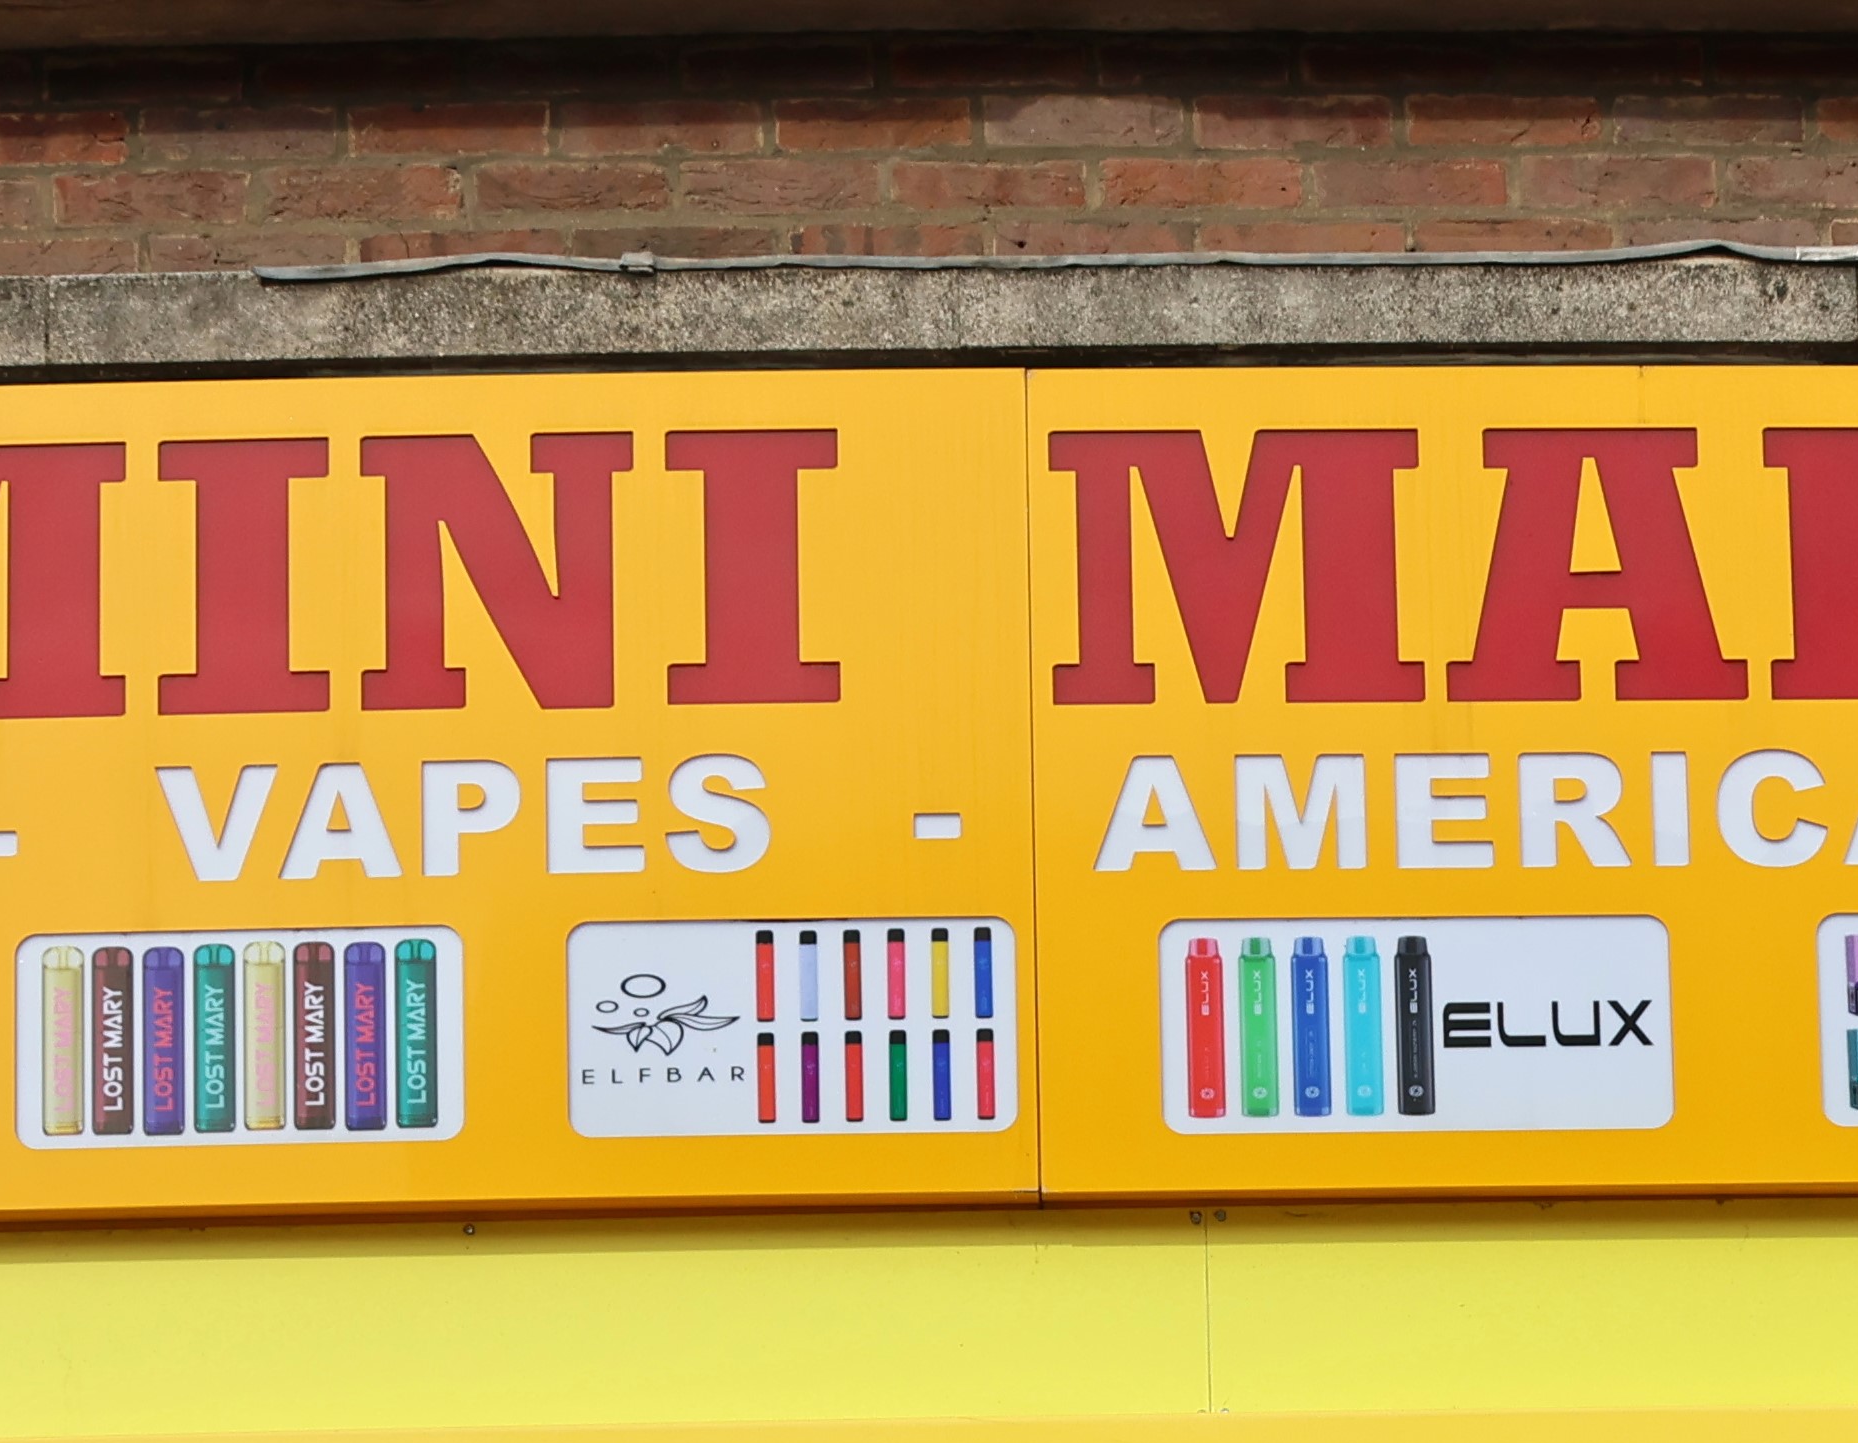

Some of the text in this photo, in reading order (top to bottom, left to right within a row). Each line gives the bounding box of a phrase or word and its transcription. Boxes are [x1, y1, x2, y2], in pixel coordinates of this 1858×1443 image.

[155, 754, 770, 883] VAPES
[1201, 971, 1211, 1017] ELUX
[1409, 967, 1419, 1015] ELUX
[103, 986, 124, 1111] LOST MARY
[205, 983, 225, 1108] LOST MARY
[1443, 1000, 1654, 1049] ELUX
[582, 1066, 745, 1085] ELFBAR
